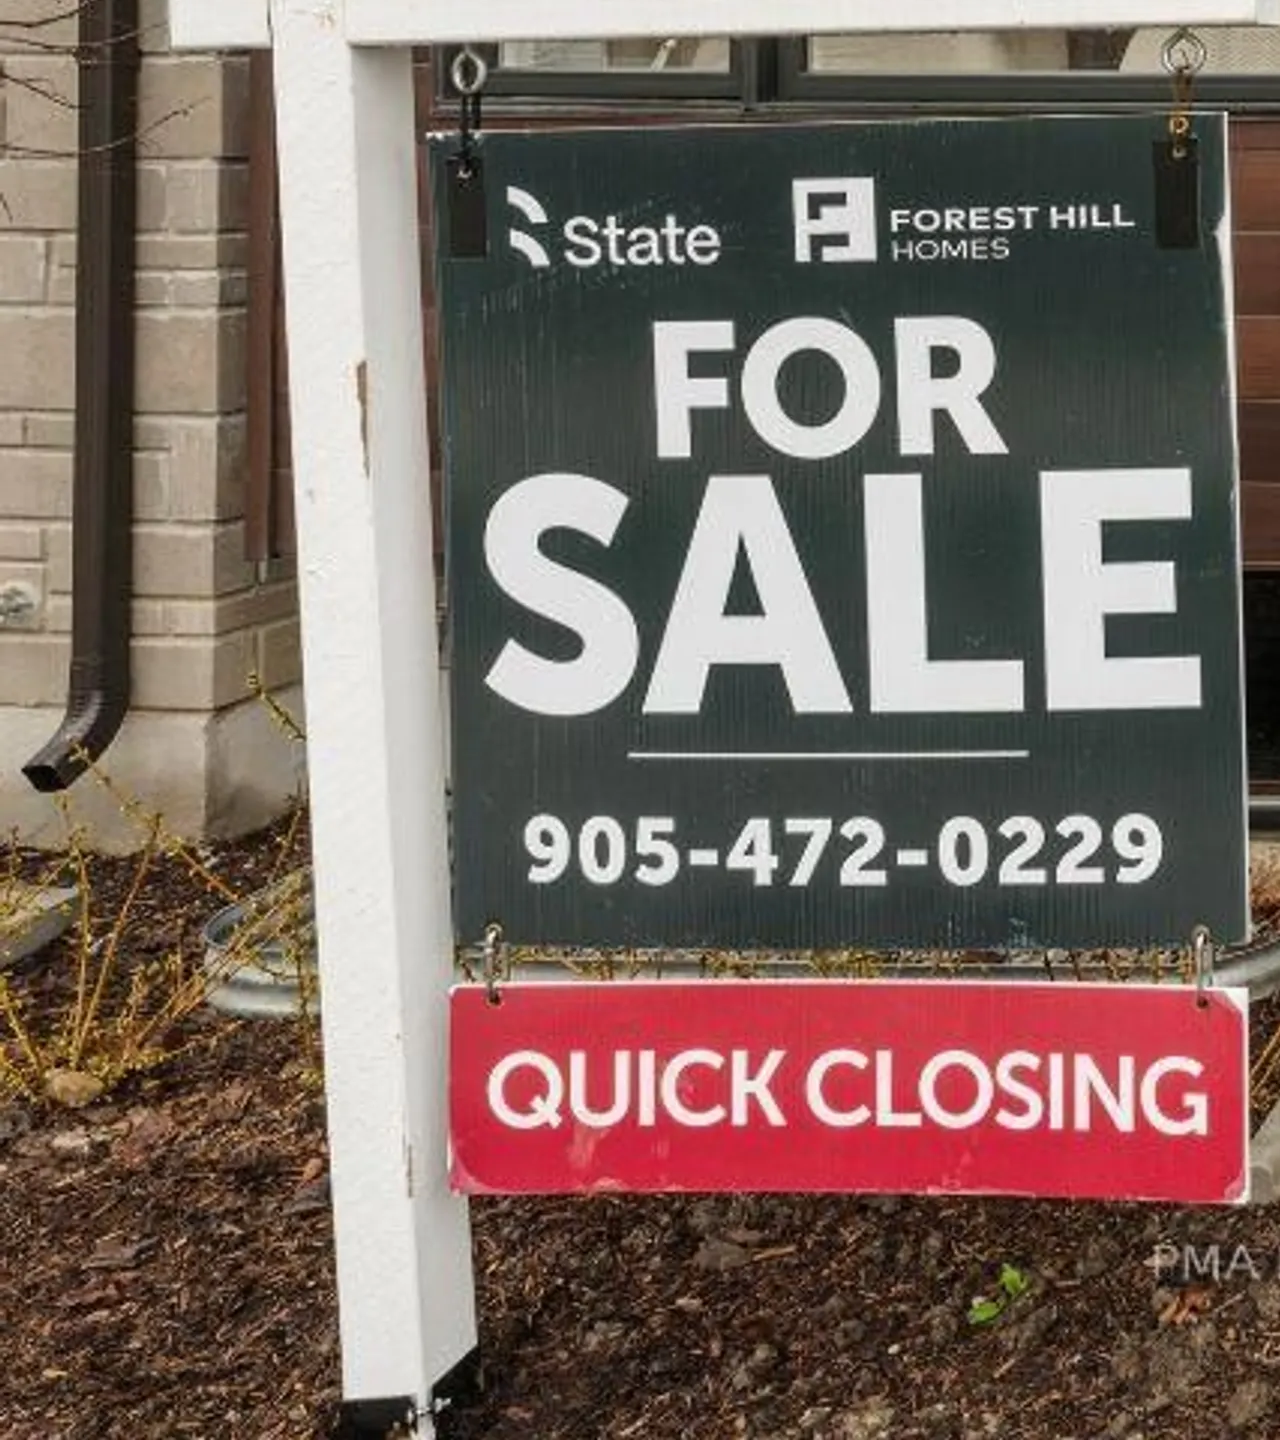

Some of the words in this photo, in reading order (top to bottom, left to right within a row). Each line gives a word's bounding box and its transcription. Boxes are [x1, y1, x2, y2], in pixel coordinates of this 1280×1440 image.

[563, 215, 721, 266] State
[890, 207, 1039, 232] FOREST
[1050, 204, 1135, 228] HILL
[891, 237, 1010, 261] HOMES
[653, 316, 1009, 459] FOR
[483, 468, 1202, 716] SALE
[523, 812, 1163, 887] 905-472-0229
[486, 1048, 787, 1130] QUICK
[805, 1048, 1208, 1136] CLOSING
